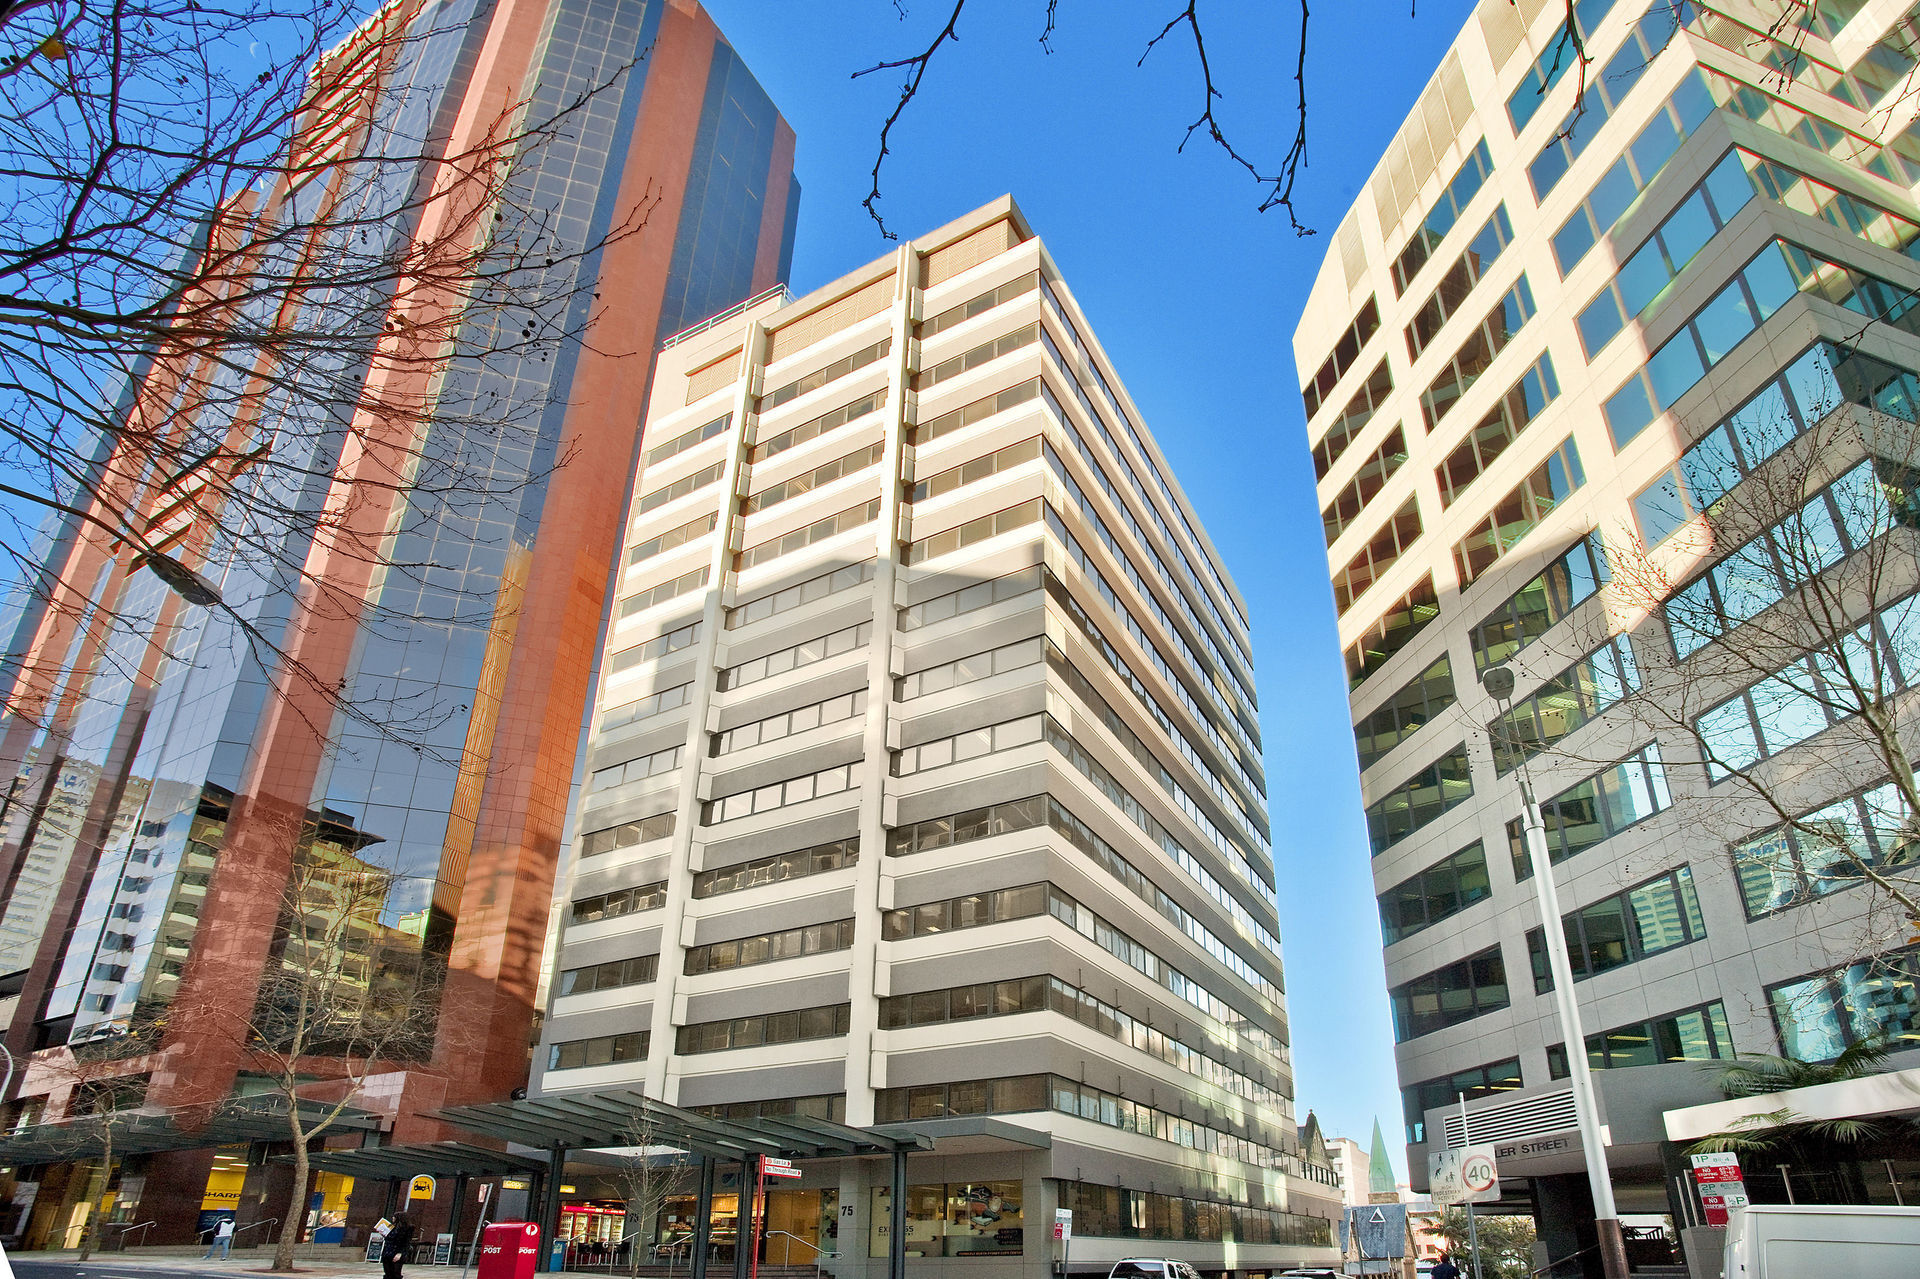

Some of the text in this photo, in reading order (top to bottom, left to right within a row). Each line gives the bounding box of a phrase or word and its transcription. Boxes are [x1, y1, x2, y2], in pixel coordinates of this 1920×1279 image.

[1521, 1138, 1570, 1153] STREET
[1468, 1164, 1490, 1181] 40
[841, 1206, 853, 1216] 75
